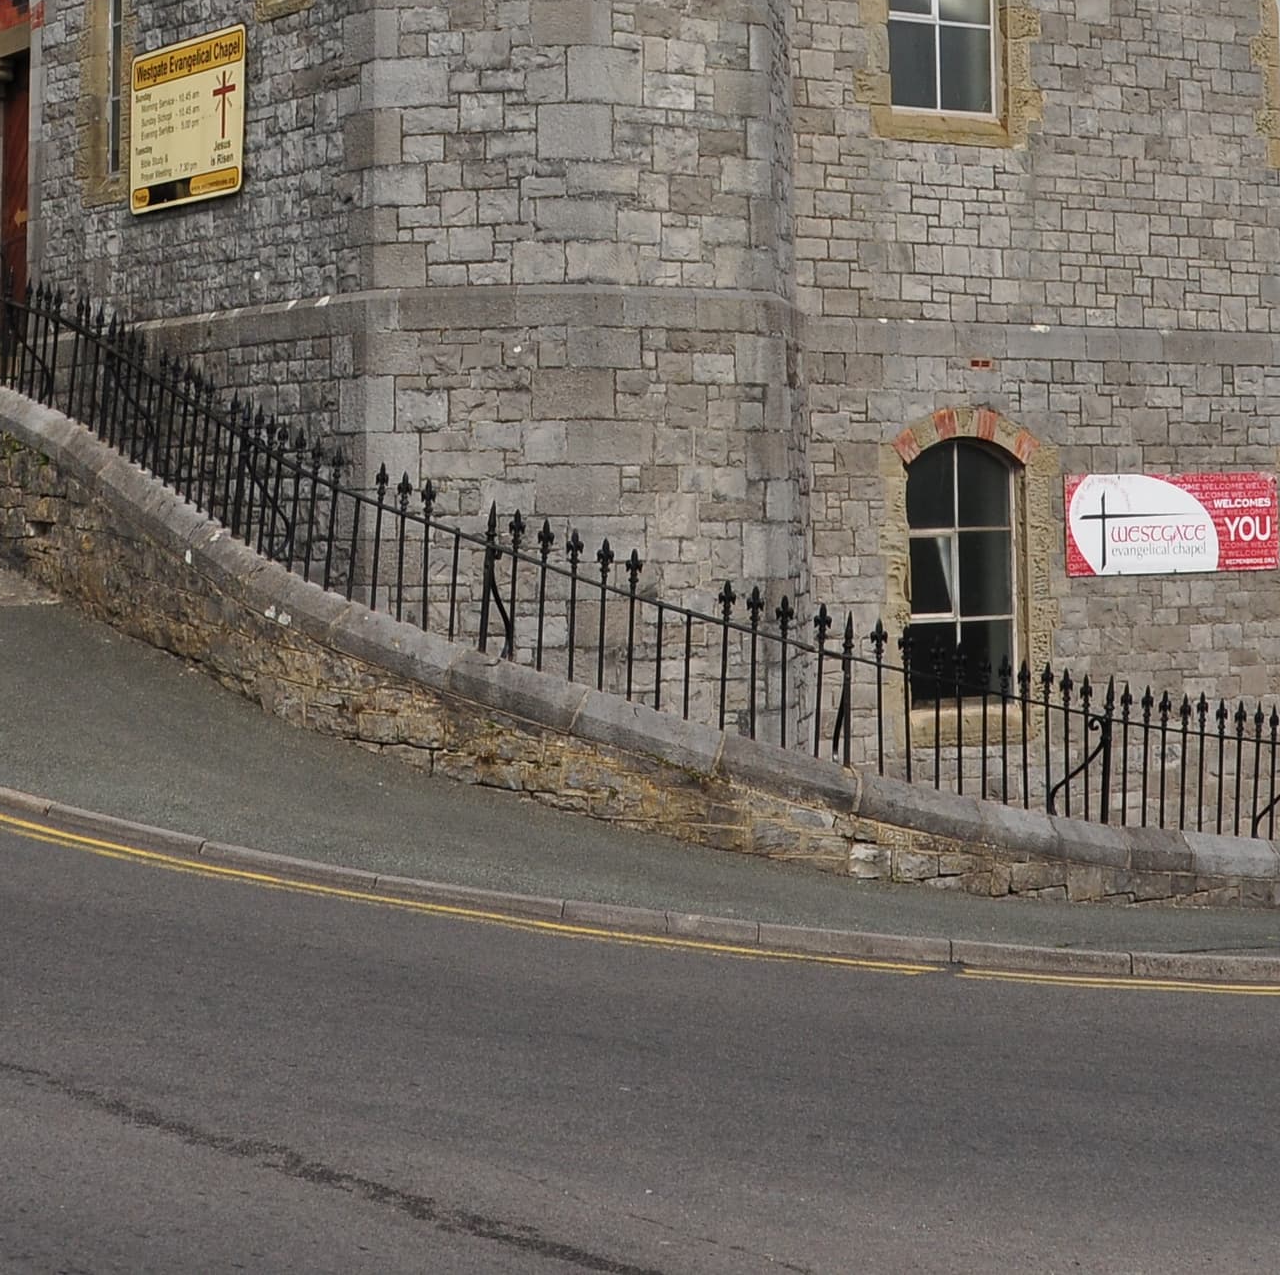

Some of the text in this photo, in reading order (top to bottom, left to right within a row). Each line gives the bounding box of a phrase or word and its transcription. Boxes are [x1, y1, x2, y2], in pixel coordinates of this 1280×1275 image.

[136, 36, 240, 83] Westgate Evangelical Chapel
[135, 92, 152, 104] Sunday
[141, 102, 158, 113] Morning
[159, 98, 175, 109] Service
[192, 90, 199, 99] am
[141, 117, 156, 127] Sunday
[157, 112, 172, 123] School
[192, 105, 200, 114] am
[141, 130, 158, 141] Evening
[159, 125, 175, 137] Service
[135, 146, 153, 156] Tuesday
[214, 140, 231, 152] Jesus
[152, 156, 163, 167] Study
[210, 153, 234, 166] is Risen
[1201, 482, 1243, 491] WELCOME
[1213, 497, 1271, 508] WELCOMES
[1111, 524, 1206, 545] WESTGATE
[1224, 515, 1271, 542] YOU
[1111, 540, 1206, 560] evangelical chapel
